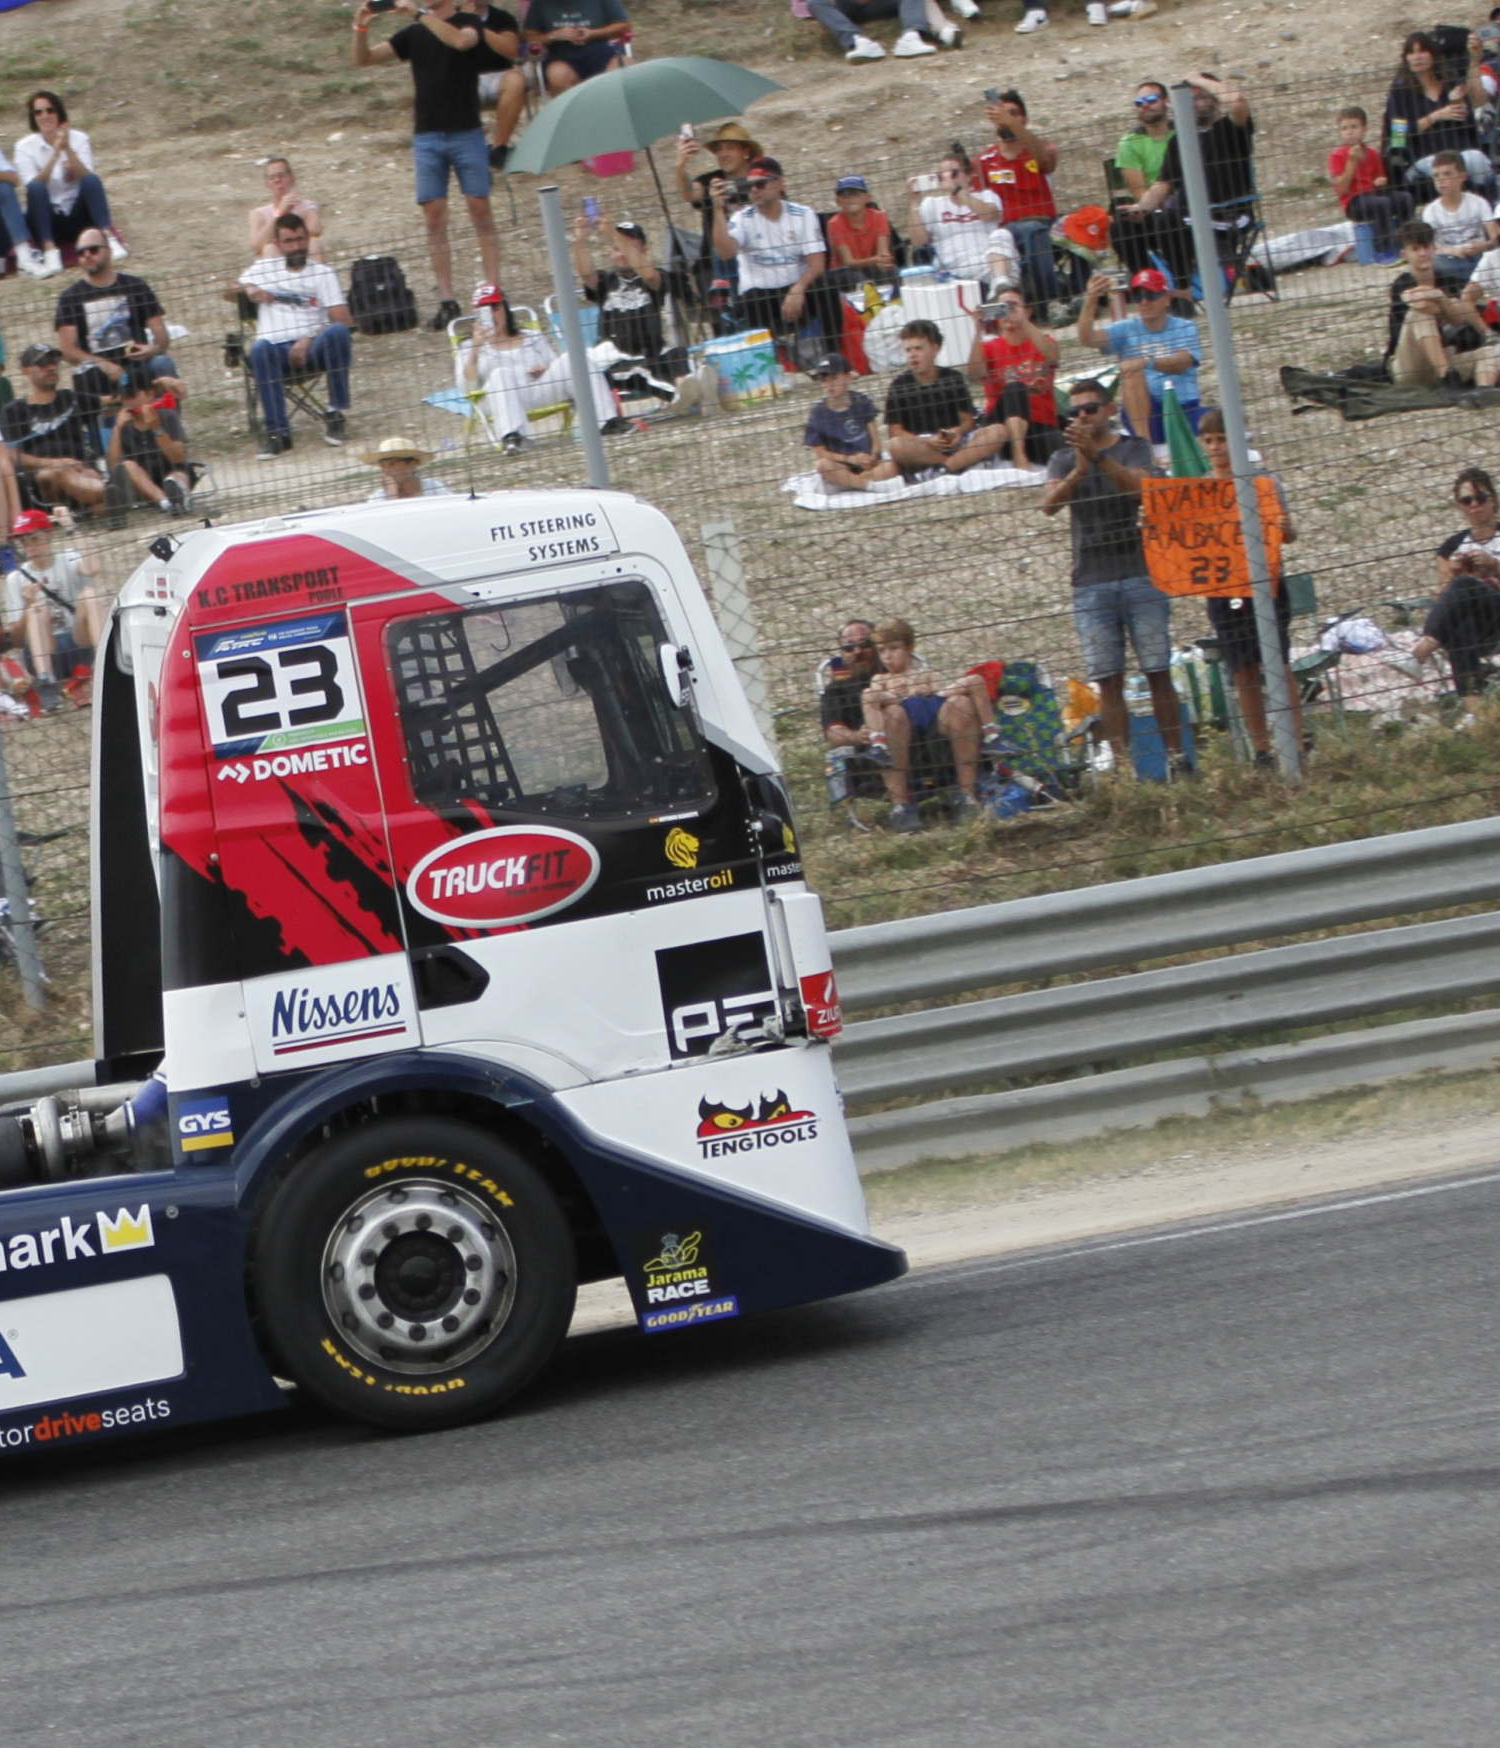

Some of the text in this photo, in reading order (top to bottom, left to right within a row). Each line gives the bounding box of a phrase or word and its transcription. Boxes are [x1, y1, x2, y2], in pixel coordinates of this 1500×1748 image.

[490, 513, 596, 542] FTL STEERING
[528, 536, 600, 561] SYSTEMS
[1190, 556, 1231, 584] 23
[197, 566, 339, 609] K.C TRANSPORT
[308, 586, 342, 602] POOLE
[216, 645, 345, 738] 23
[253, 744, 368, 781] DOMETIC
[429, 850, 570, 900] TRUCKFIT
[766, 862, 802, 877] maste
[646, 869, 733, 901] masteroil
[272, 984, 400, 1037] Nissens
[179, 1109, 231, 1133] GYS
[646, 1266, 708, 1288] Jarama
[647, 1279, 711, 1304] RACE
[647, 1301, 734, 1327] GOODYEAR
